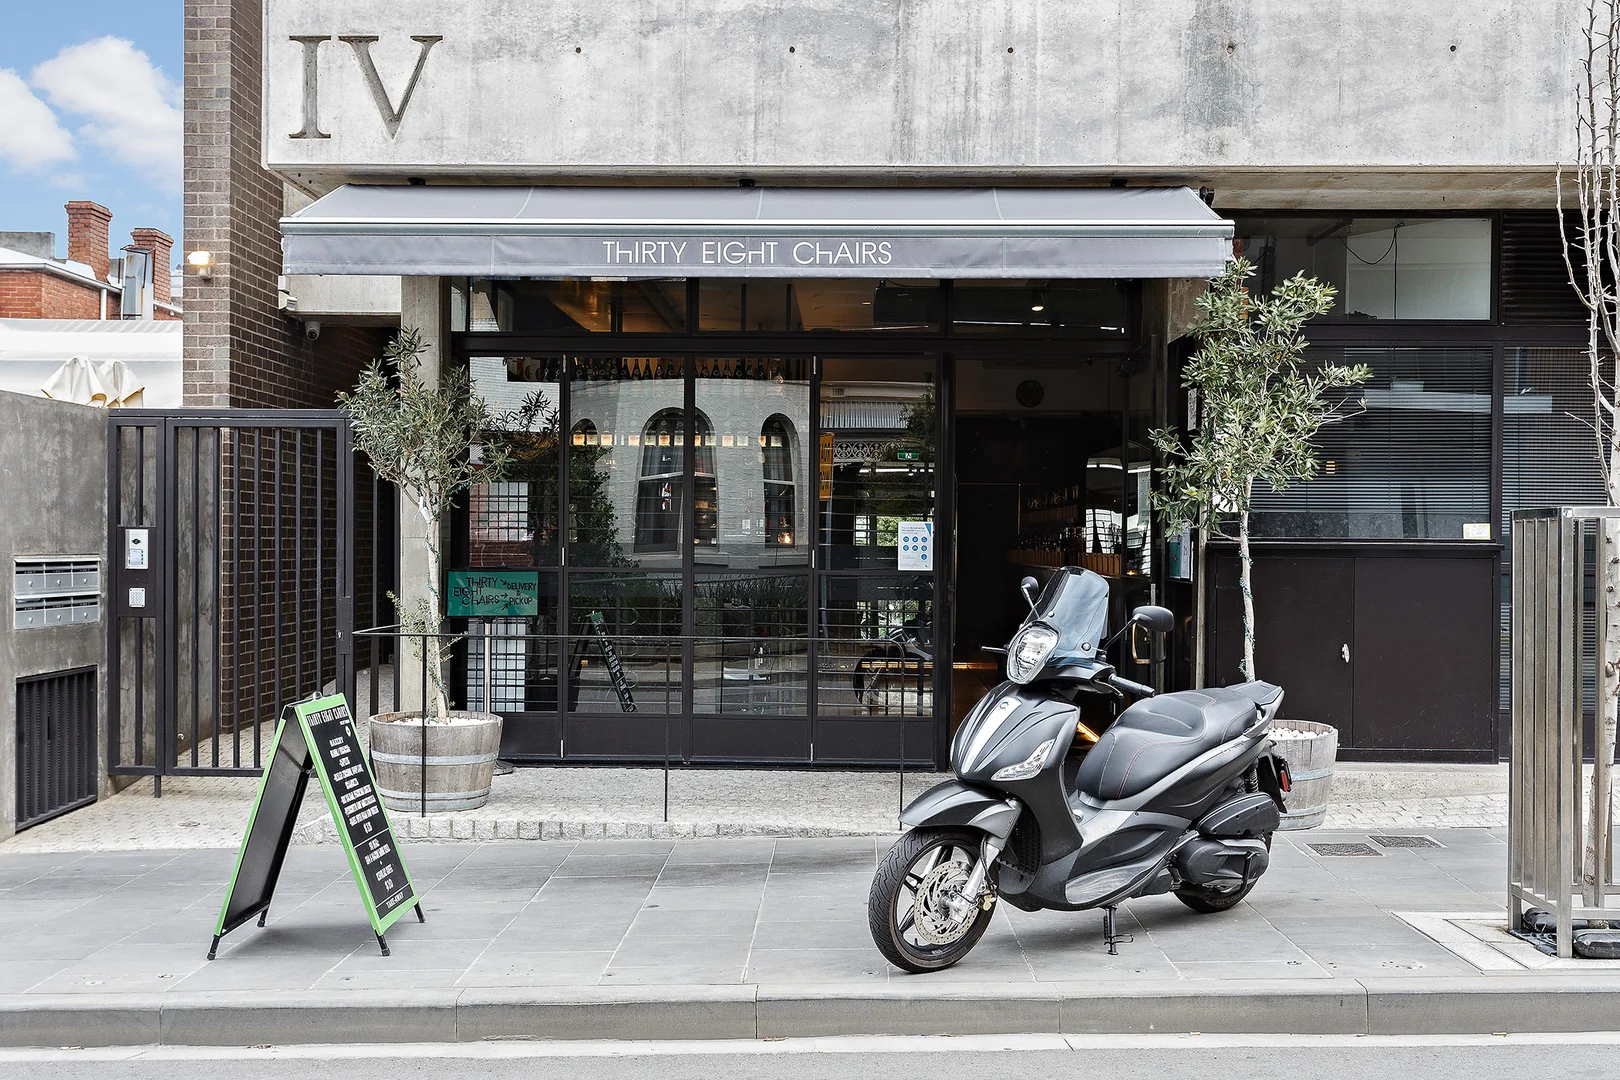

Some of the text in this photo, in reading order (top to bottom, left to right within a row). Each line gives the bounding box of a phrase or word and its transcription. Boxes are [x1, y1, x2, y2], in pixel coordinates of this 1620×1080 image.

[289, 35, 443, 139] IV
[602, 241, 892, 264] THIRTY EIGHT CHAIRS
[466, 576, 498, 588] THIRTY
[506, 582, 536, 591] DELIVERY
[453, 586, 482, 597] EIGHT
[461, 594, 500, 606] CHAIRS
